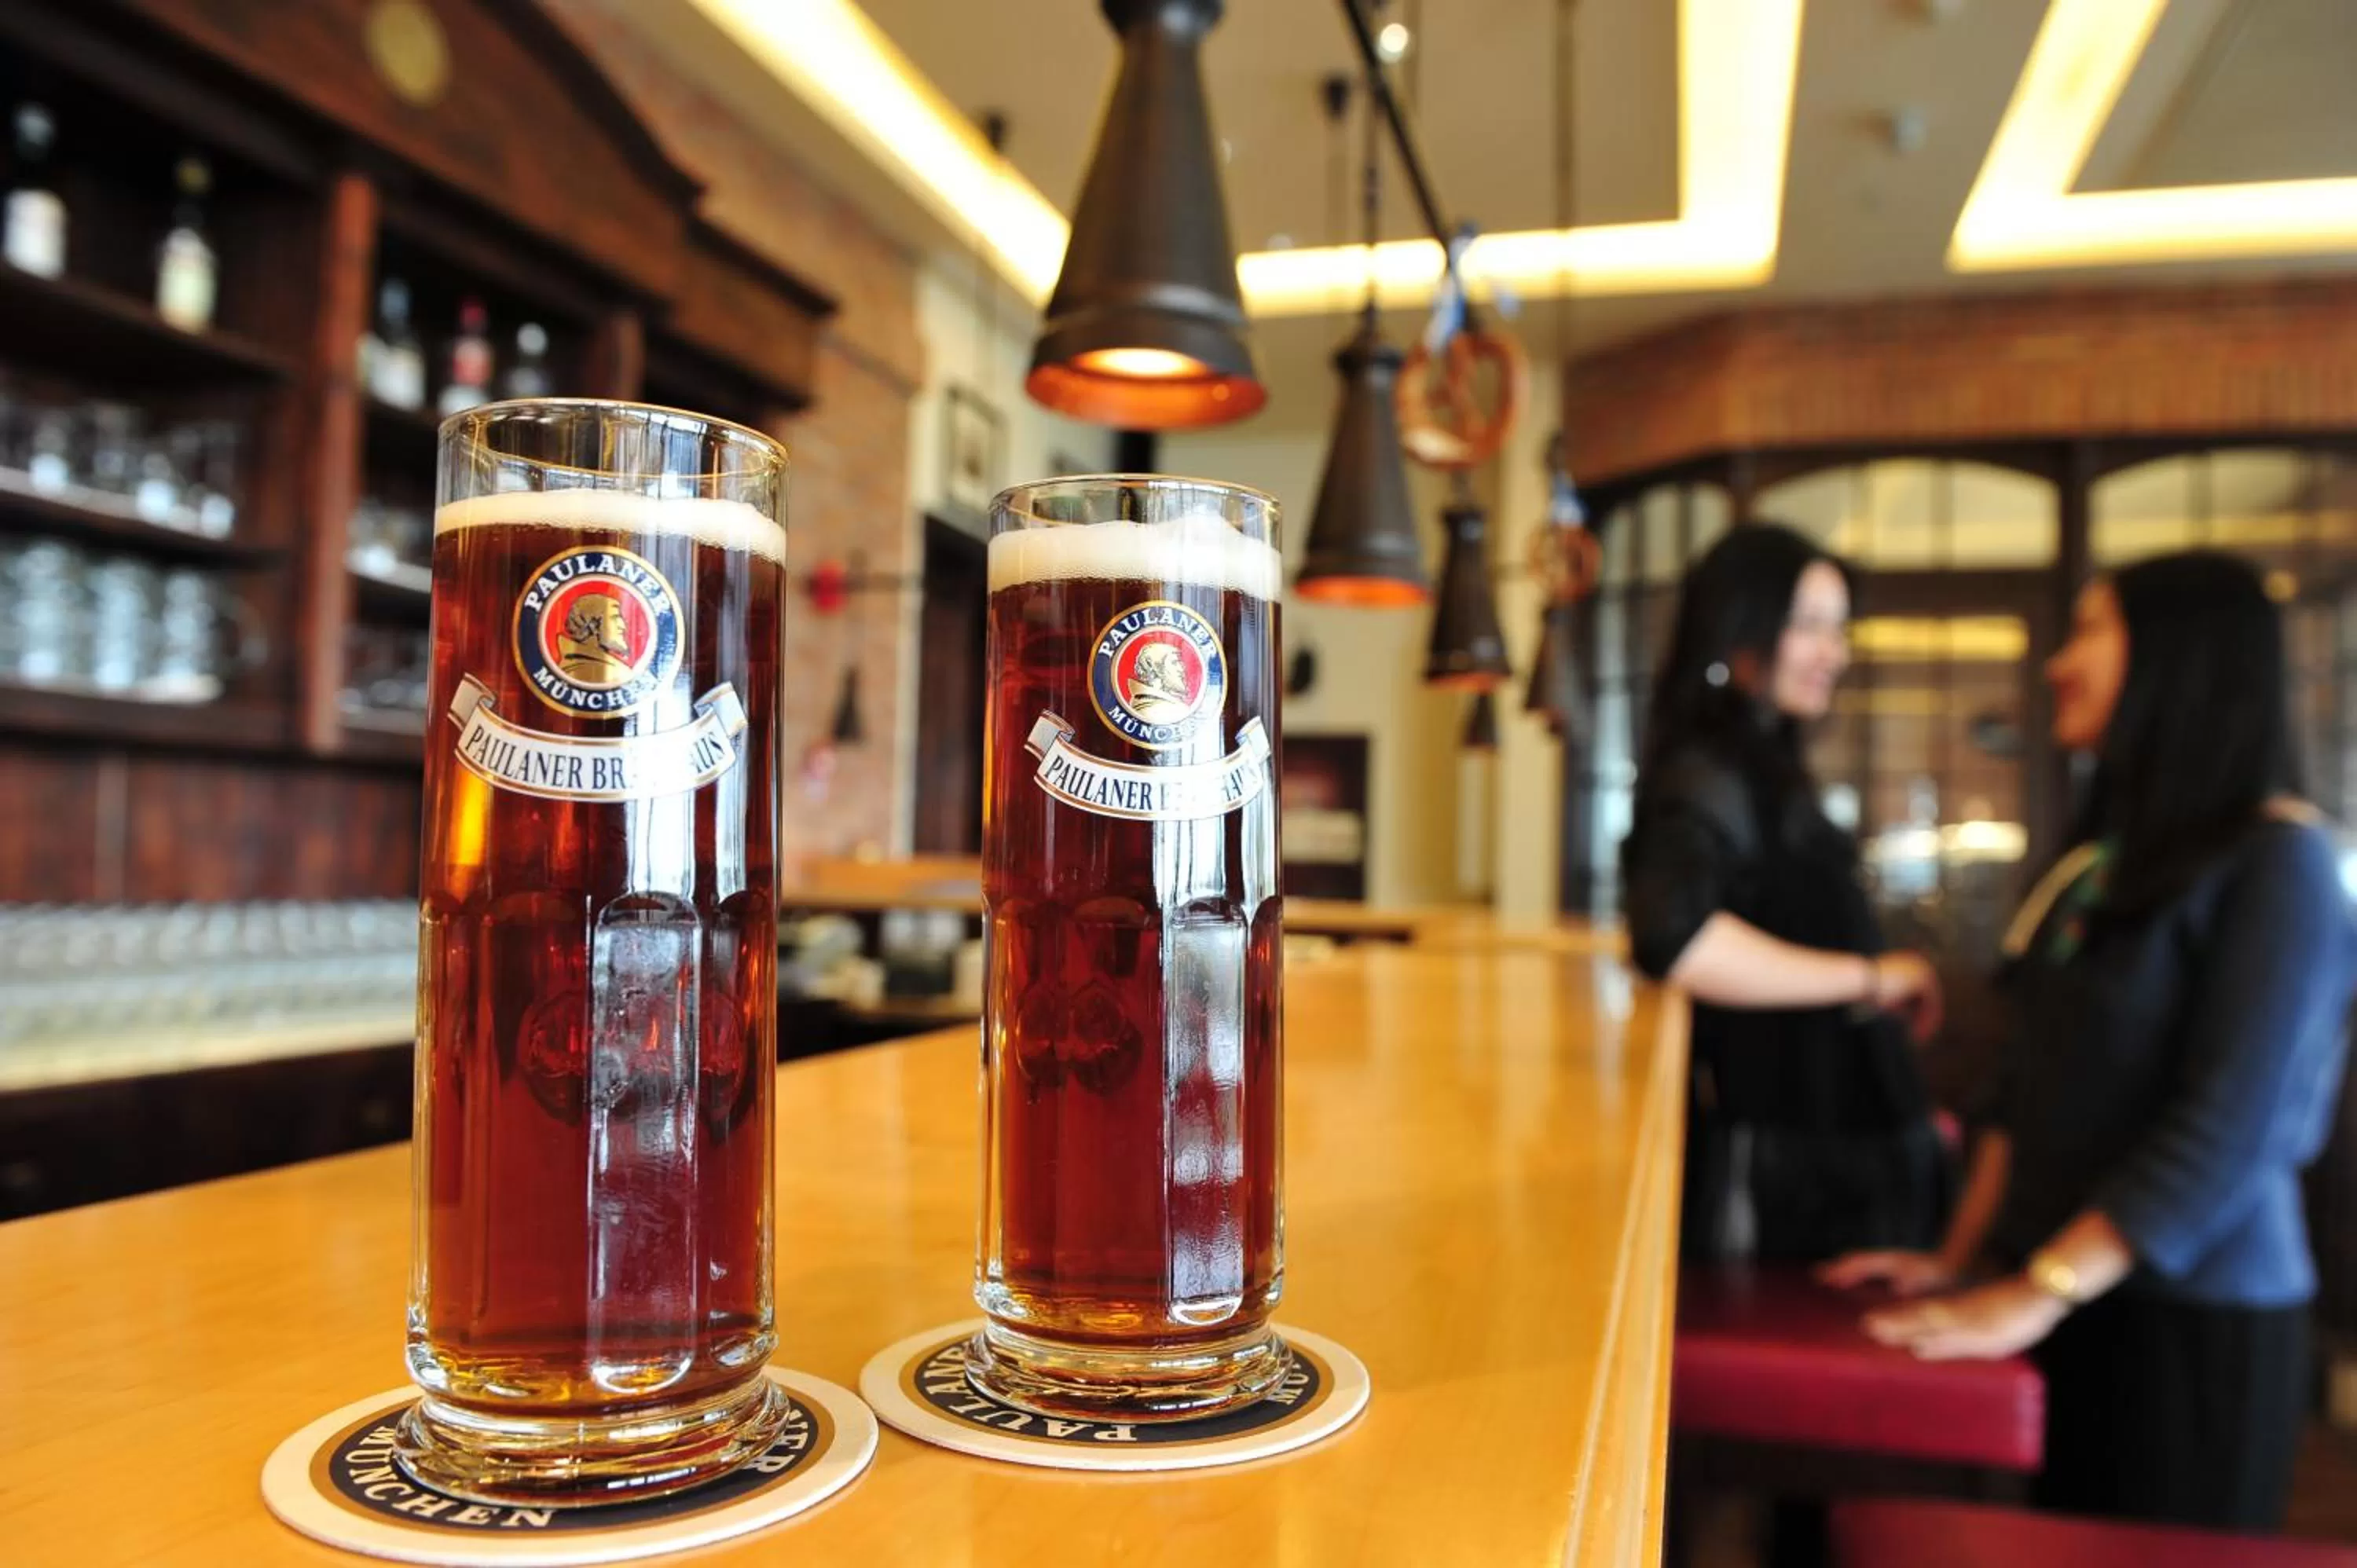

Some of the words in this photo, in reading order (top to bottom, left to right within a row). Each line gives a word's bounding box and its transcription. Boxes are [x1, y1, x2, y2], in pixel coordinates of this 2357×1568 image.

[524, 554, 671, 614] PAULANER
[1098, 607, 1217, 658] PAULANER
[533, 666, 661, 709] MÜNCH
[465, 724, 583, 789] PAULANER
[591, 731, 726, 790] BRUS
[1044, 754, 1153, 811] PAULANER
[923, 1342, 1138, 1442] PAULANE
